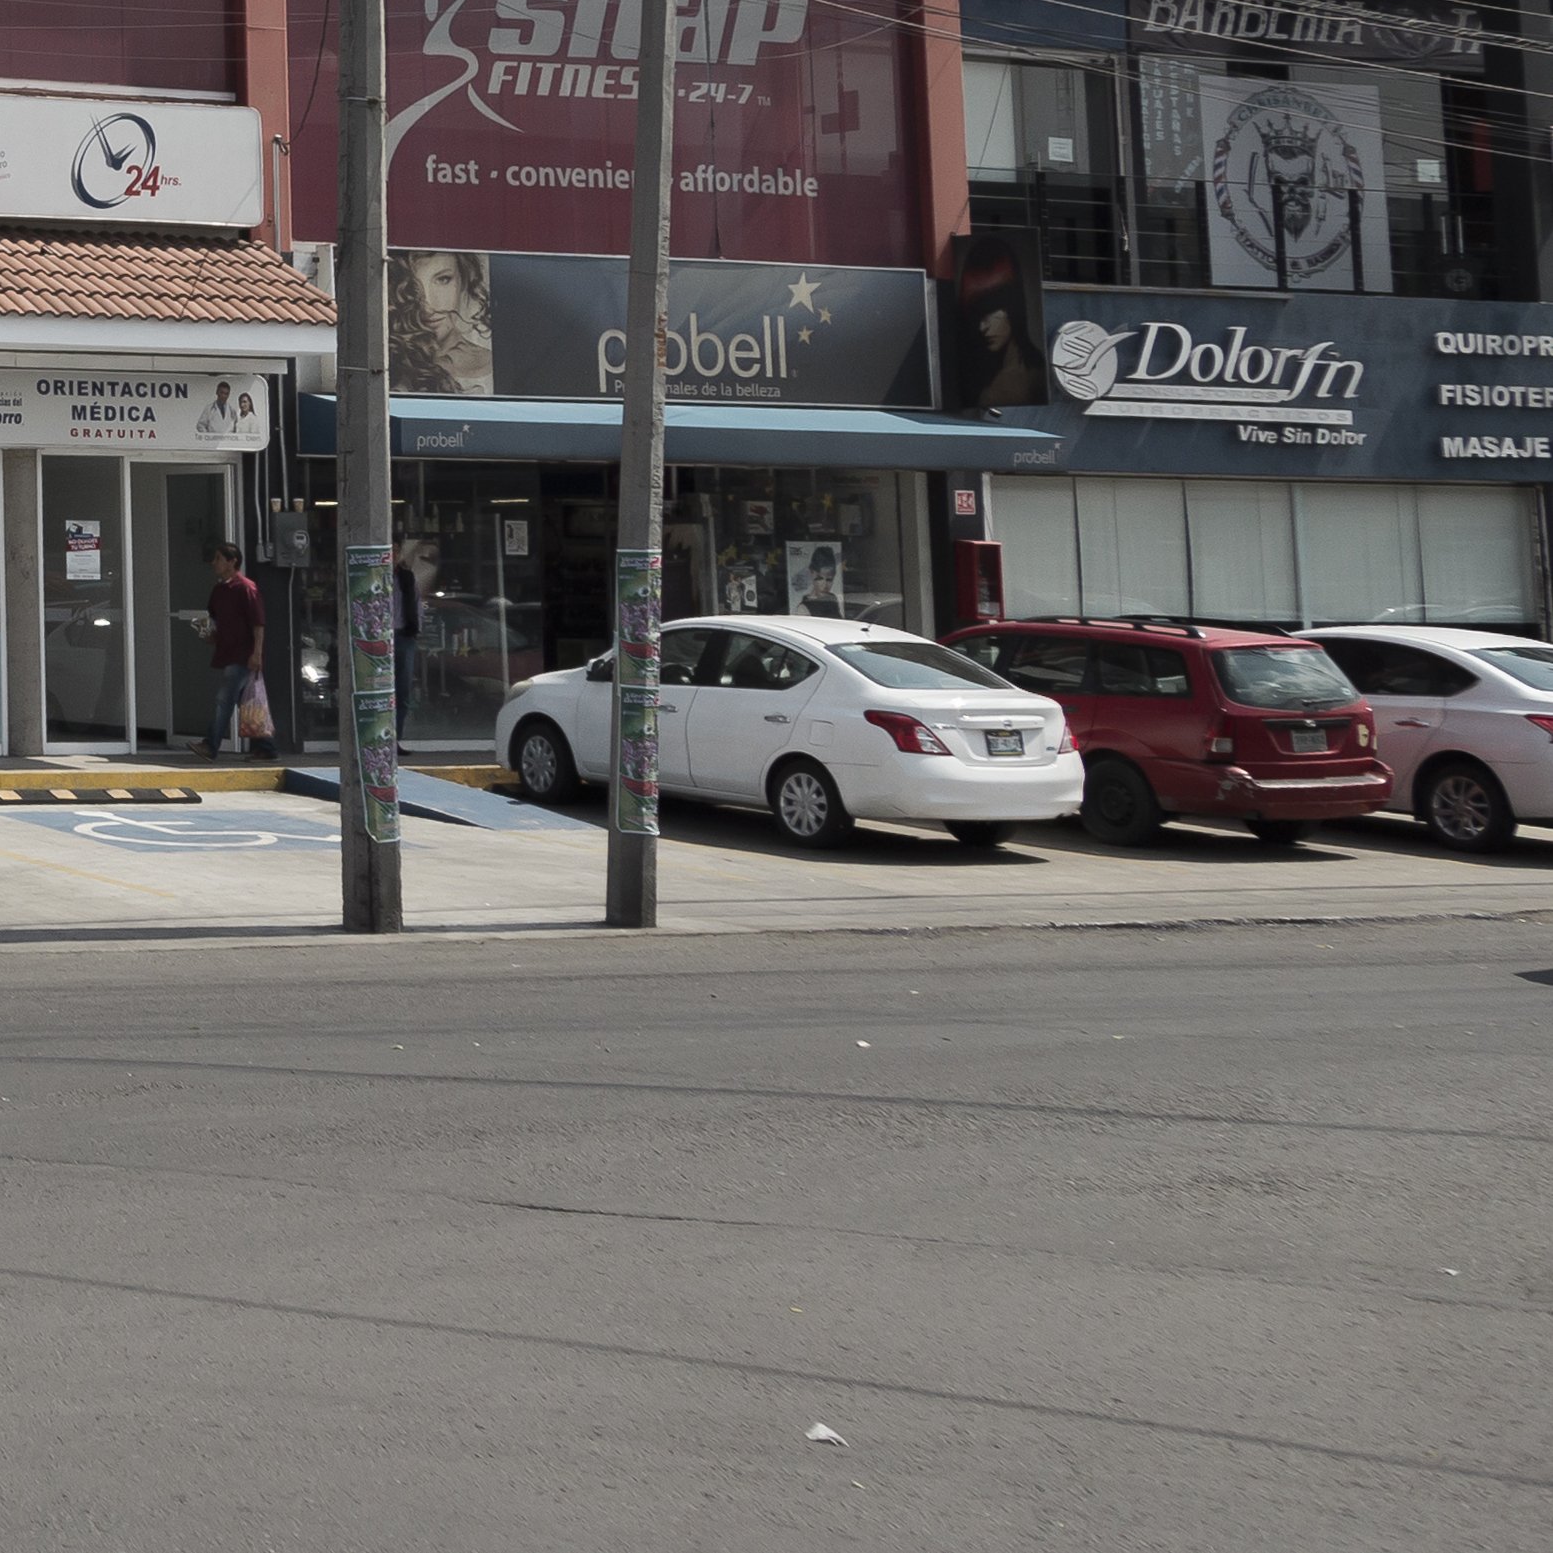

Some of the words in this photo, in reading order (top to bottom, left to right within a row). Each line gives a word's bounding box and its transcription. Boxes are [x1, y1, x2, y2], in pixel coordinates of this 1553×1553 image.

[124, 164, 160, 198] 24
[160, 174, 183, 187] hrs.
[425, 154, 480, 185] fast
[679, 166, 819, 198] affordable
[36, 378, 190, 399] ORIENTACION
[701, 381, 717, 396] de
[720, 382, 733, 396] la
[735, 383, 782, 398] belleza
[12, 397, 23, 407] del
[71, 401, 158, 423] MÉDICA
[70, 427, 158, 440] GRATUITA
[416, 431, 465, 451] probell
[1237, 424, 1278, 443] Vive
[1282, 427, 1313, 445] Sin
[1316, 429, 1368, 446] Dolor
[1013, 447, 1056, 467] probell
[1441, 436, 1552, 459] MASAJE
